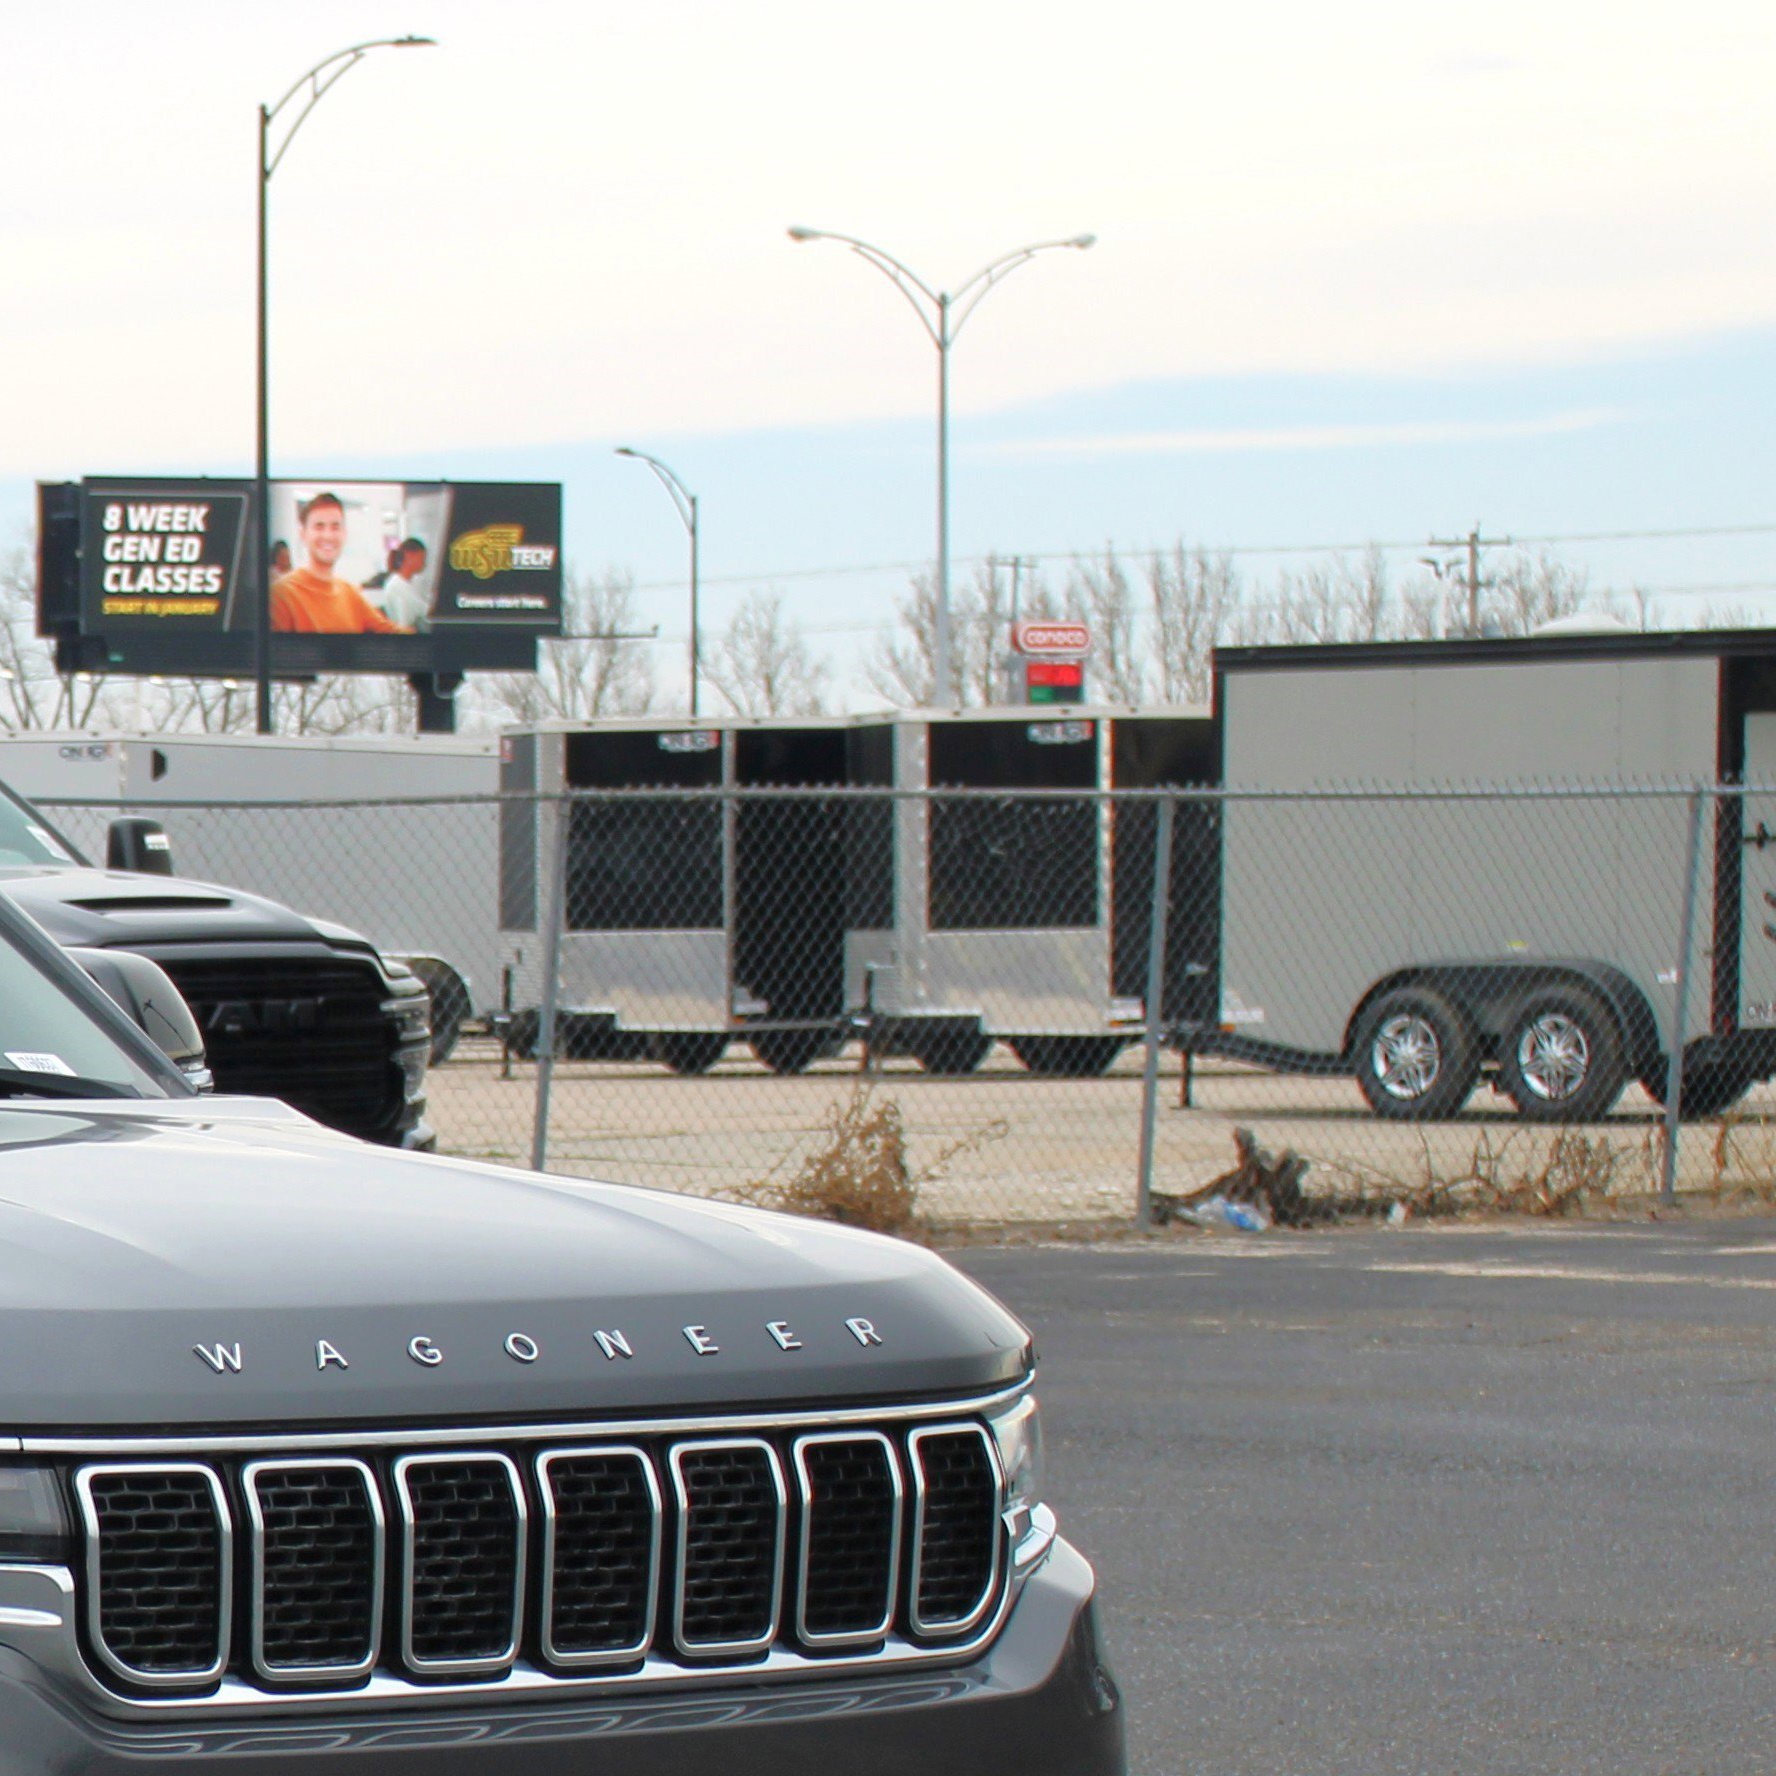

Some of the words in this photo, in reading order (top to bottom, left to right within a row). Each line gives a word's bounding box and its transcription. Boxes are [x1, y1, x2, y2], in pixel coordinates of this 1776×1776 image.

[102, 503, 123, 531] 8
[127, 503, 210, 532] WEEK
[103, 534, 162, 562] GEN
[164, 534, 203, 562] ED
[511, 545, 557, 570] TECH
[103, 564, 223, 594] CLASSES
[192, 1316, 883, 1374] WAGONEER
